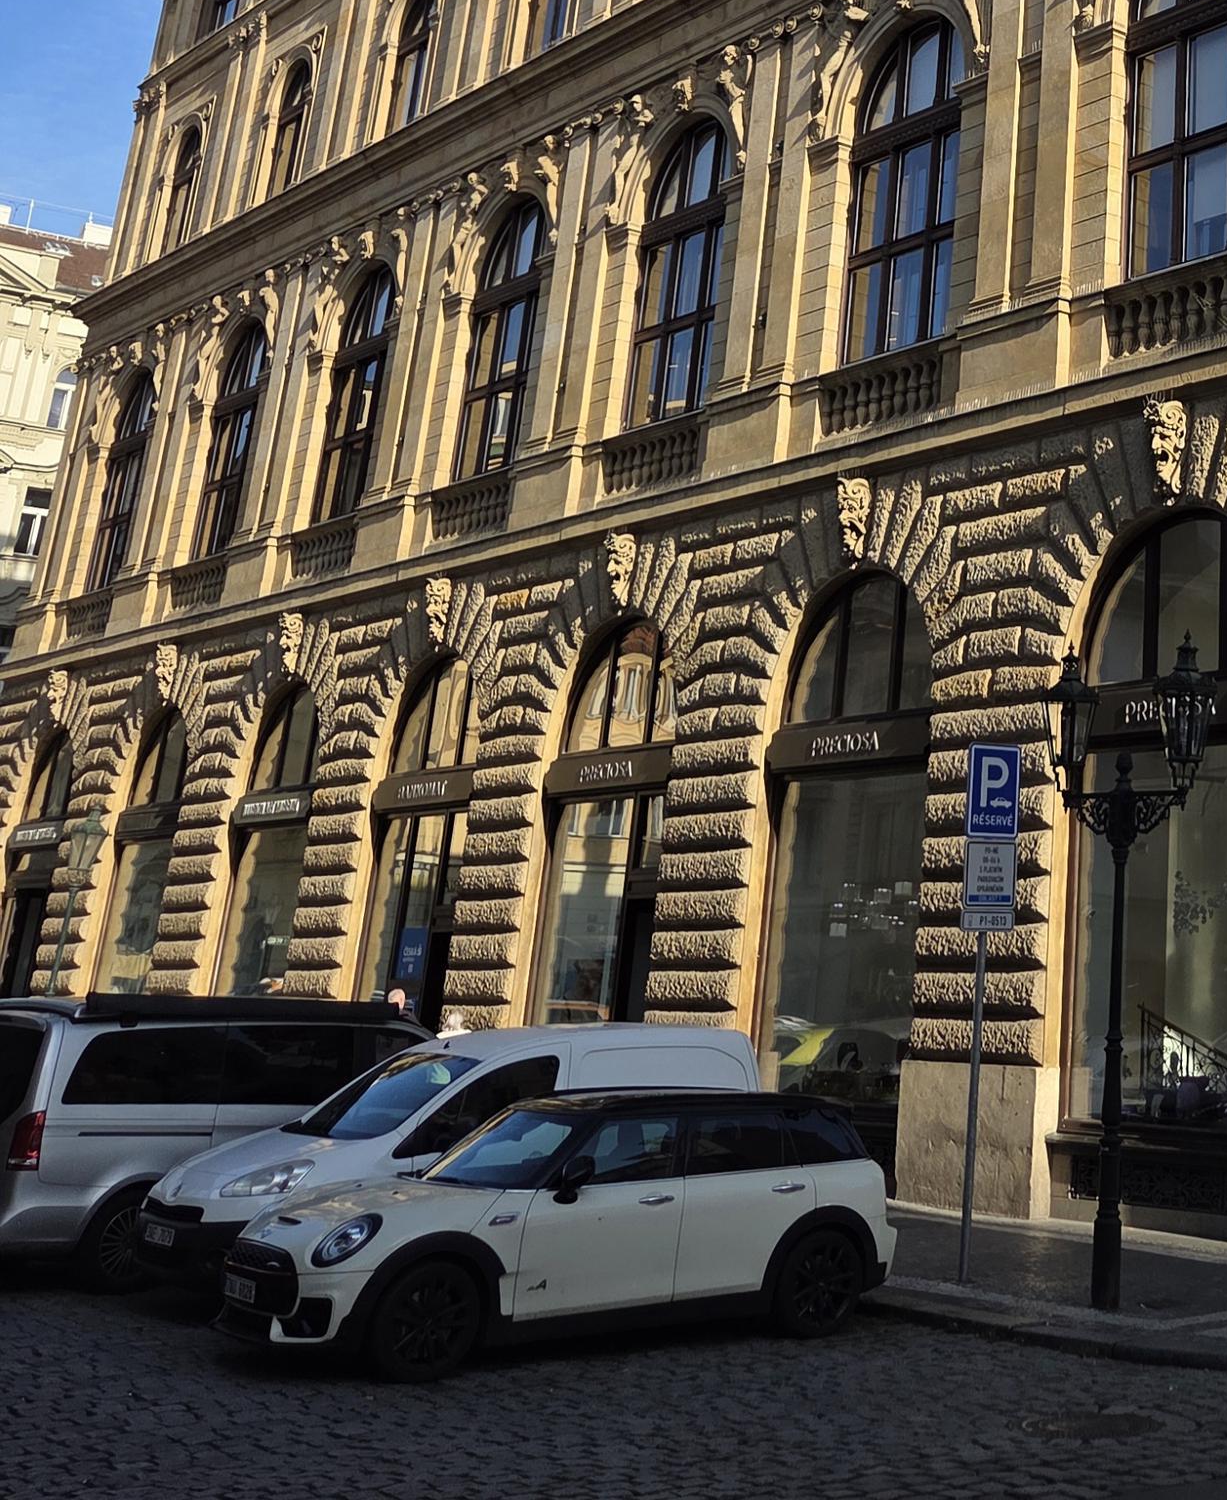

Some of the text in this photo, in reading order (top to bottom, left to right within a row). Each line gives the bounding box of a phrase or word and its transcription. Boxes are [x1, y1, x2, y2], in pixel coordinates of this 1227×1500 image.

[1125, 695, 1217, 723] PREIOSA
[811, 730, 879, 757] PRECIOSA
[980, 756, 1009, 808] P
[972, 811, 1014, 827] RÉSERVÉ
